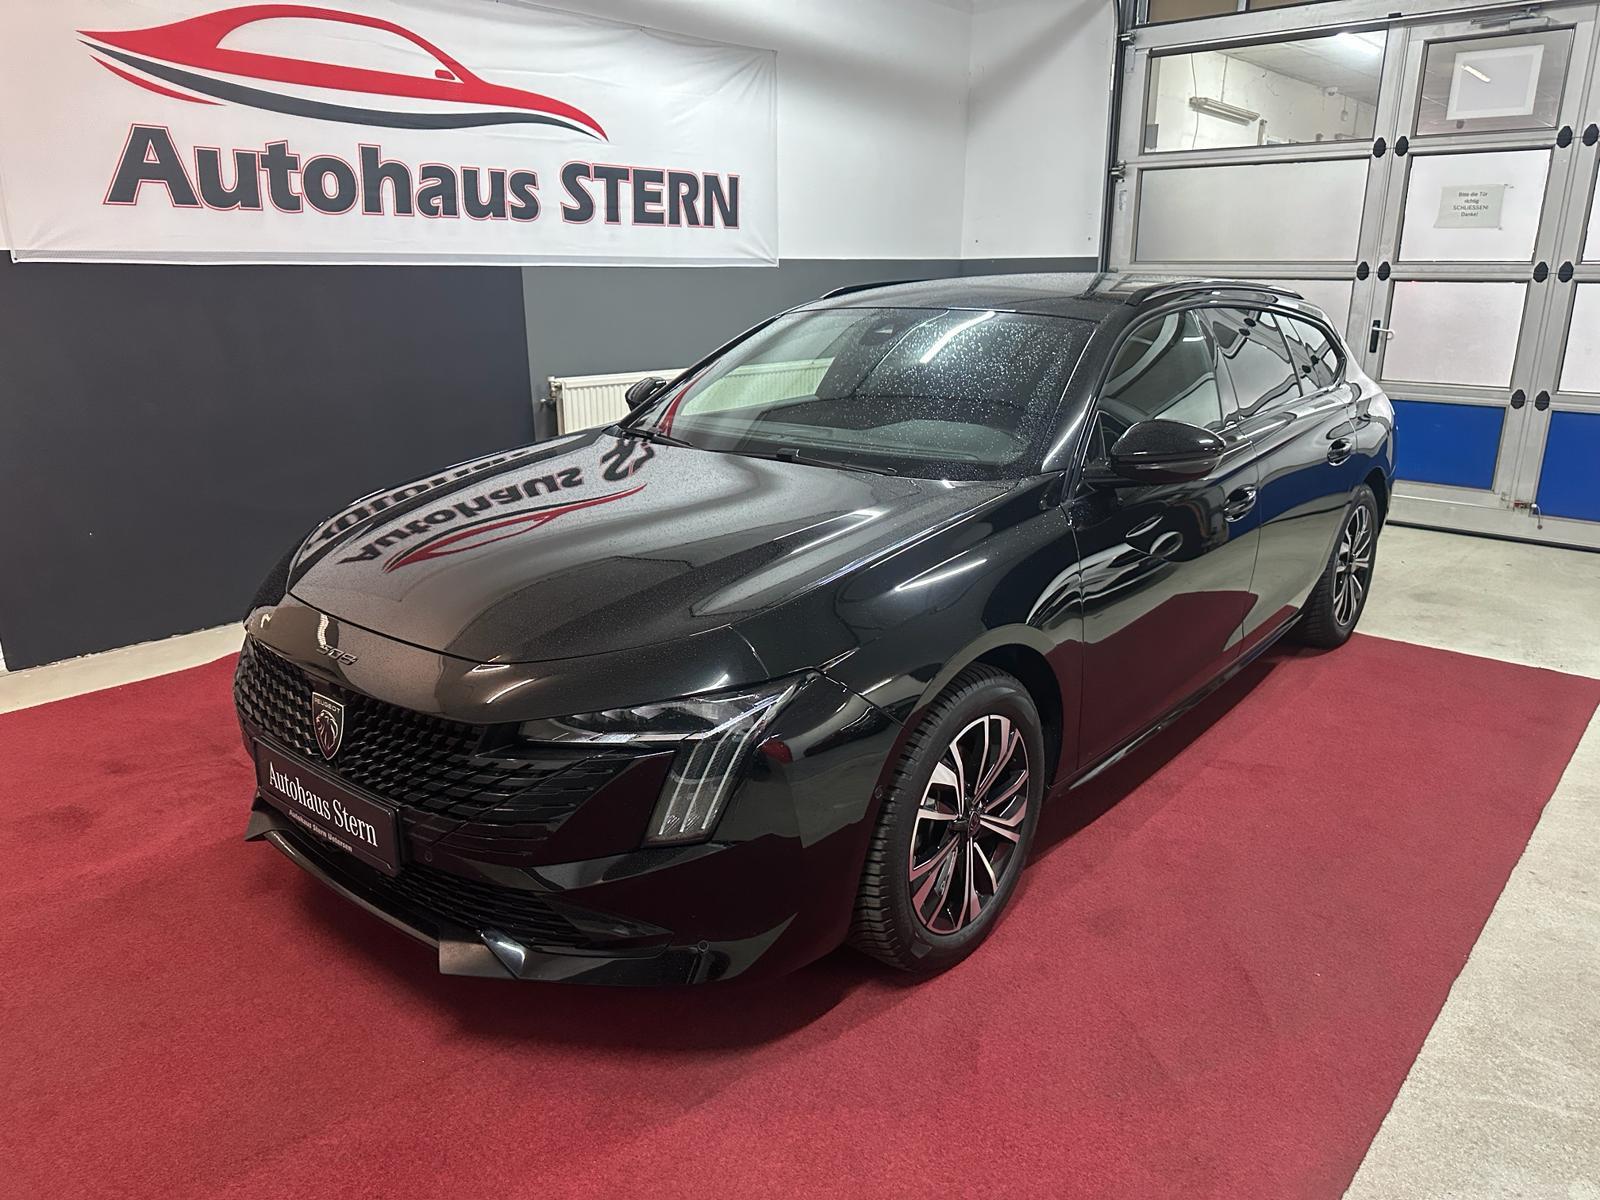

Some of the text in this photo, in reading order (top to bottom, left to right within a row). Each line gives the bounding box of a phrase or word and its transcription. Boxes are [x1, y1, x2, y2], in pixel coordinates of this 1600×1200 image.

[103, 123, 740, 230] Autohaus STERN
[316, 644, 359, 666] 508
[314, 697, 341, 714] PEUGEOT
[269, 761, 379, 848] Autohaus Stern
